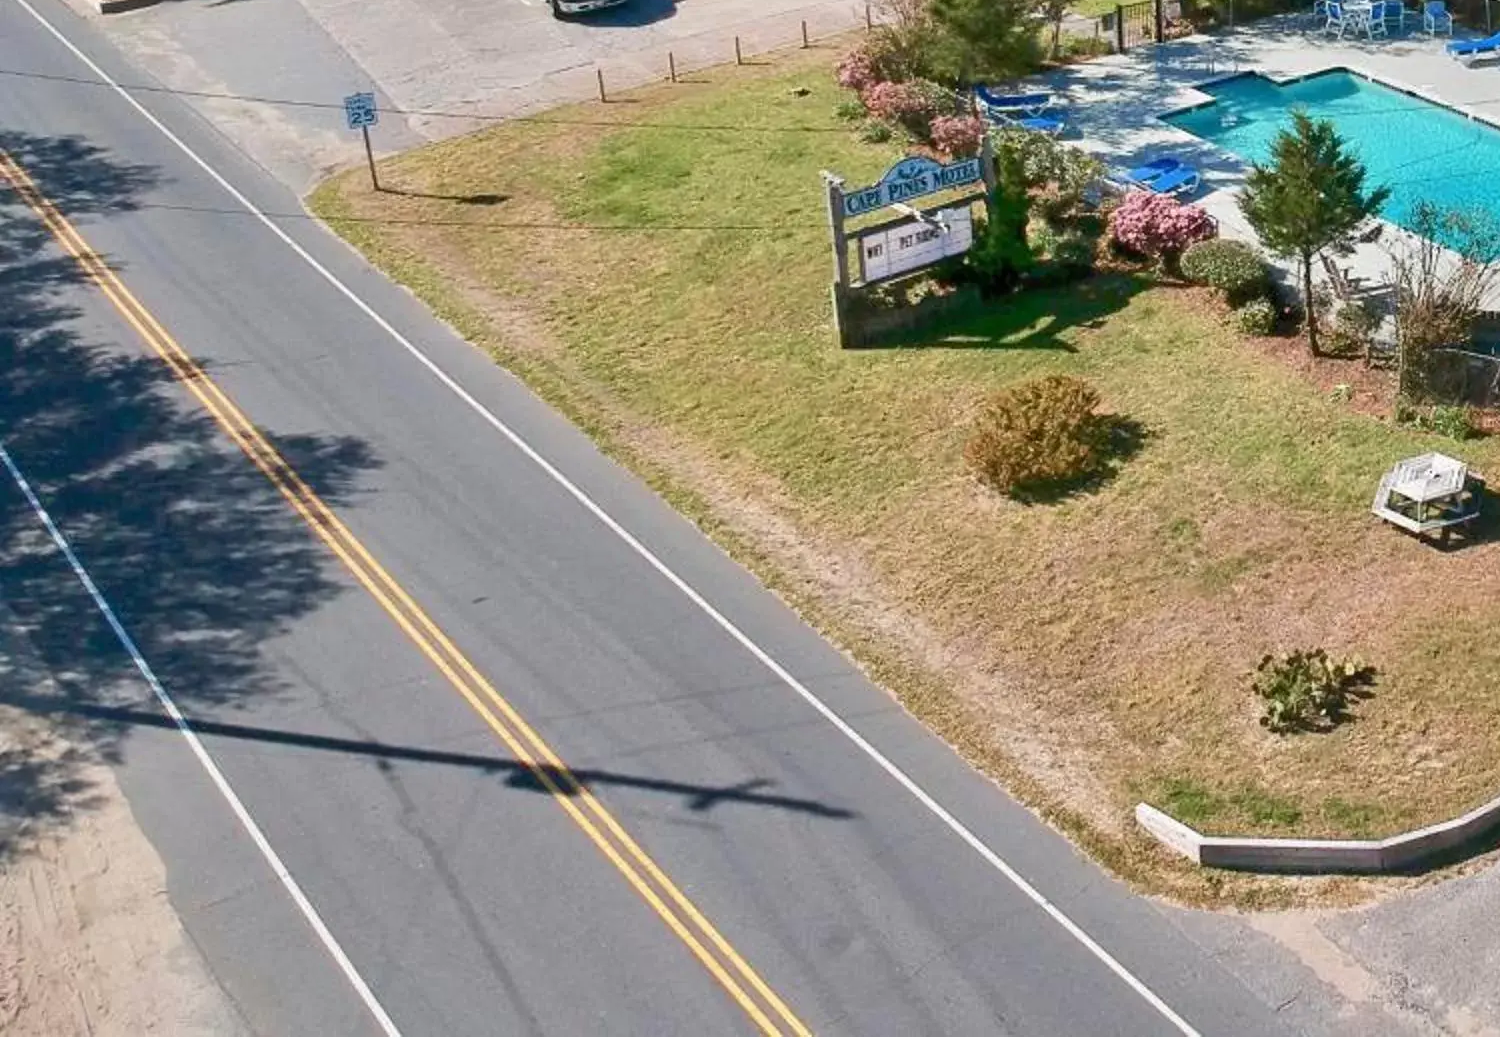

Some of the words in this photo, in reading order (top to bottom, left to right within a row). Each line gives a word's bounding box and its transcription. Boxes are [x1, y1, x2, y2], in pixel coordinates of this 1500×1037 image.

[351, 108, 375, 124] 25
[847, 191, 882, 212] CAPE
[888, 177, 928, 201] PINES
[933, 163, 976, 188] MOTEL
